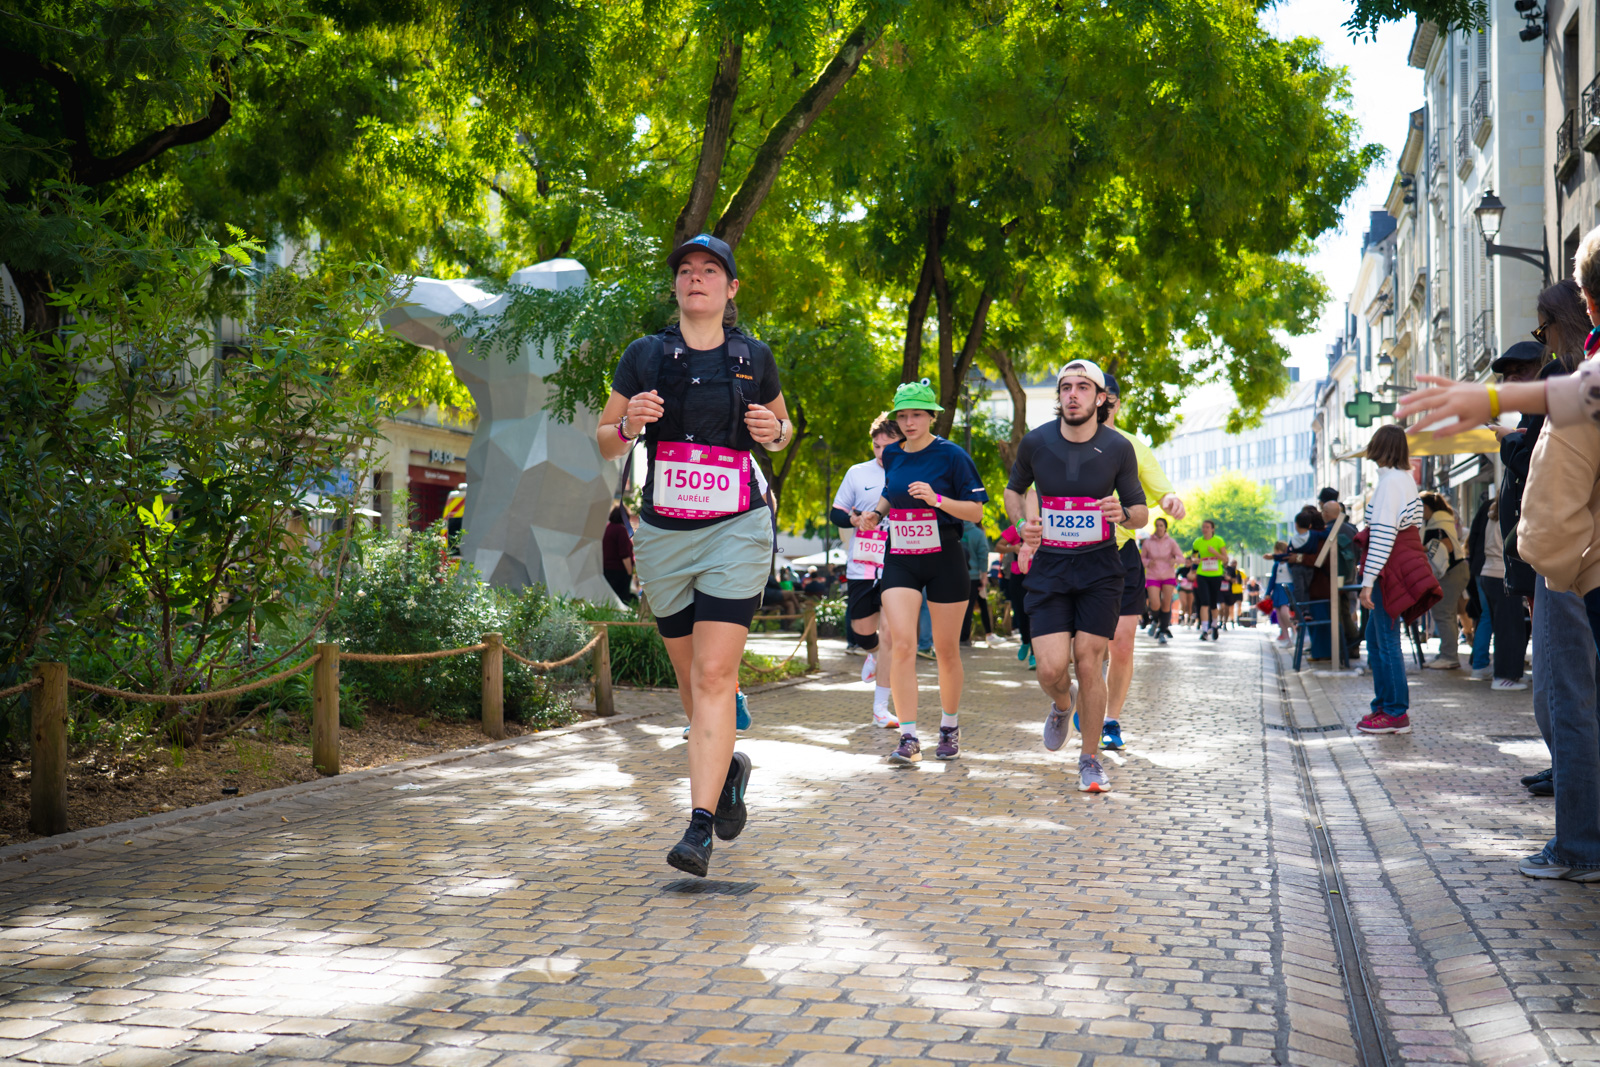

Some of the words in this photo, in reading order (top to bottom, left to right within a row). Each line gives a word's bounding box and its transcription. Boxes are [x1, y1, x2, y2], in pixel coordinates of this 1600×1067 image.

[664, 468, 730, 492] 15090
[677, 494, 710, 503] AURÉLIE
[1048, 514, 1095, 528] 12828
[894, 524, 933, 537] 10523
